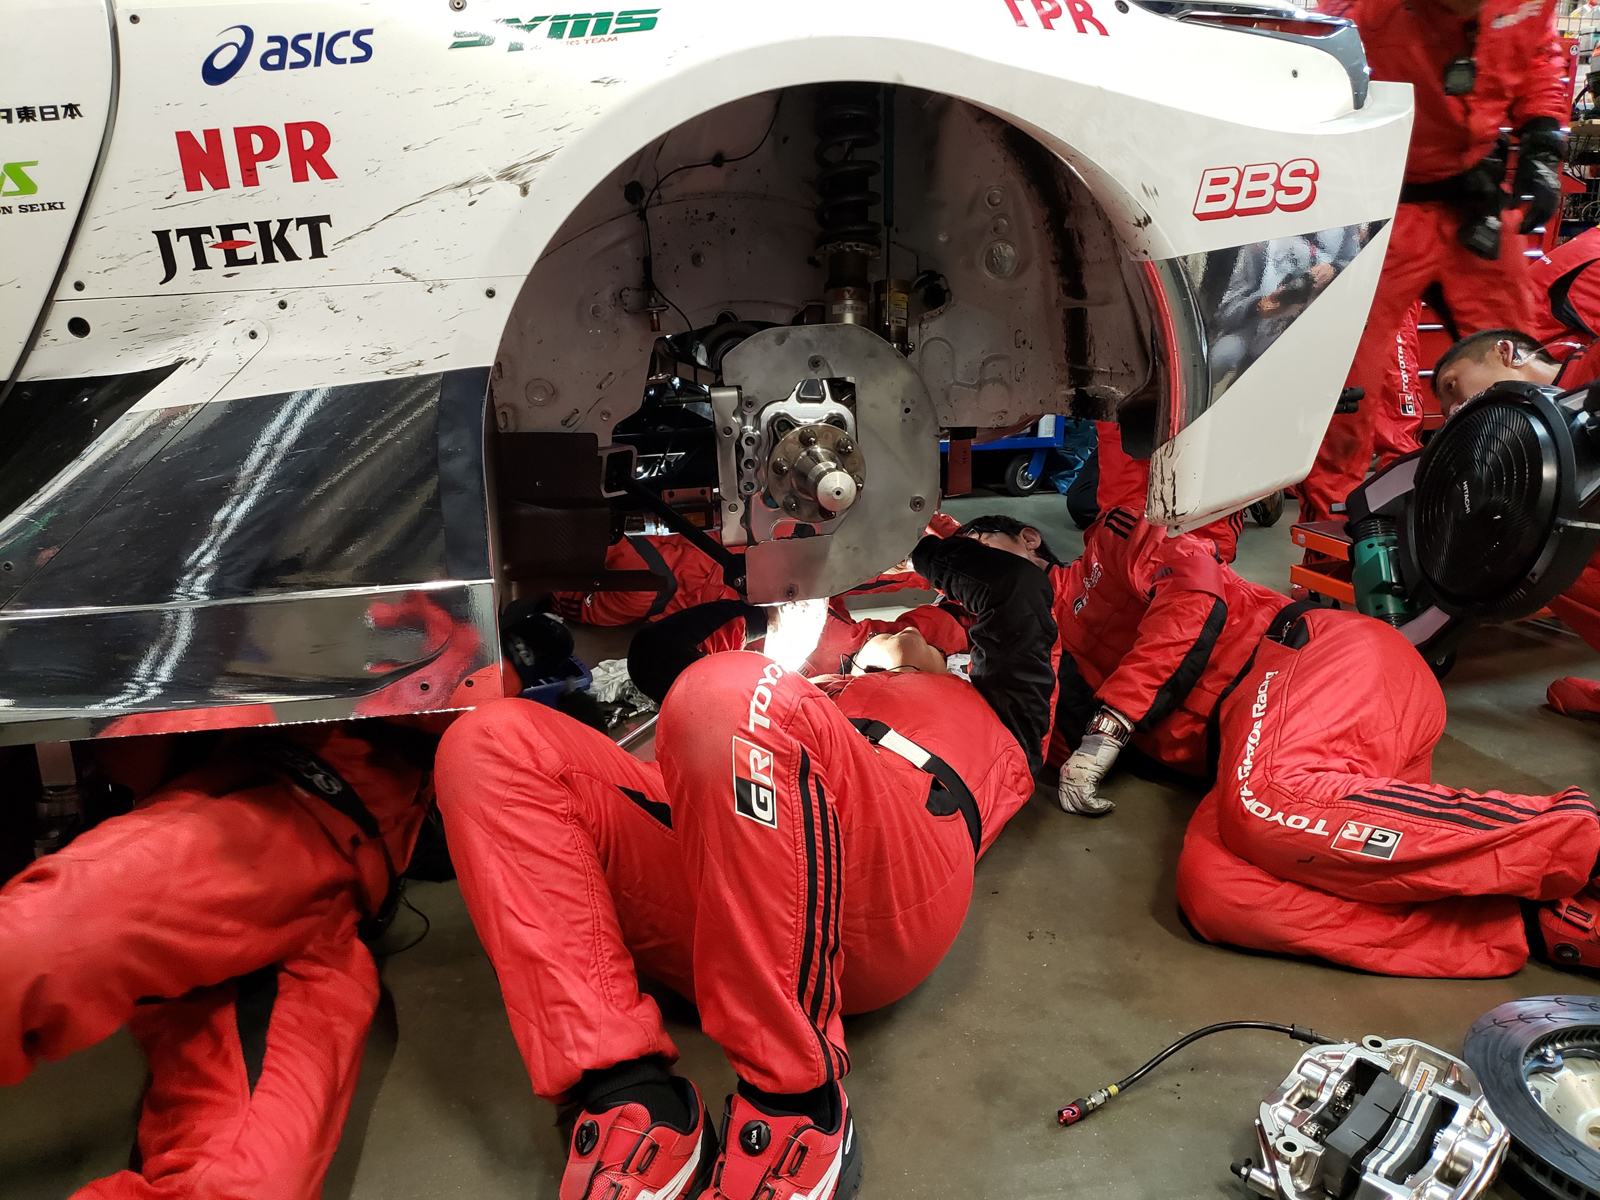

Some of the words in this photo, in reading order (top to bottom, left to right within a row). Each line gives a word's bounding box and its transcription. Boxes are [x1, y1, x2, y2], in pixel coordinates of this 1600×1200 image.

[175, 121, 339, 192] NPR
[18, 201, 66, 214] SEIKI
[1192, 158, 1319, 222] BBS
[152, 214, 332, 285] JTEKT
[1397, 346, 1409, 392] TOYOTA
[1462, 480, 1471, 514] HITACHI
[749, 662, 787, 732] TOYO
[750, 748, 774, 822] GR
[1239, 780, 1330, 836] TOYOTA
[1341, 822, 1398, 848] GR
